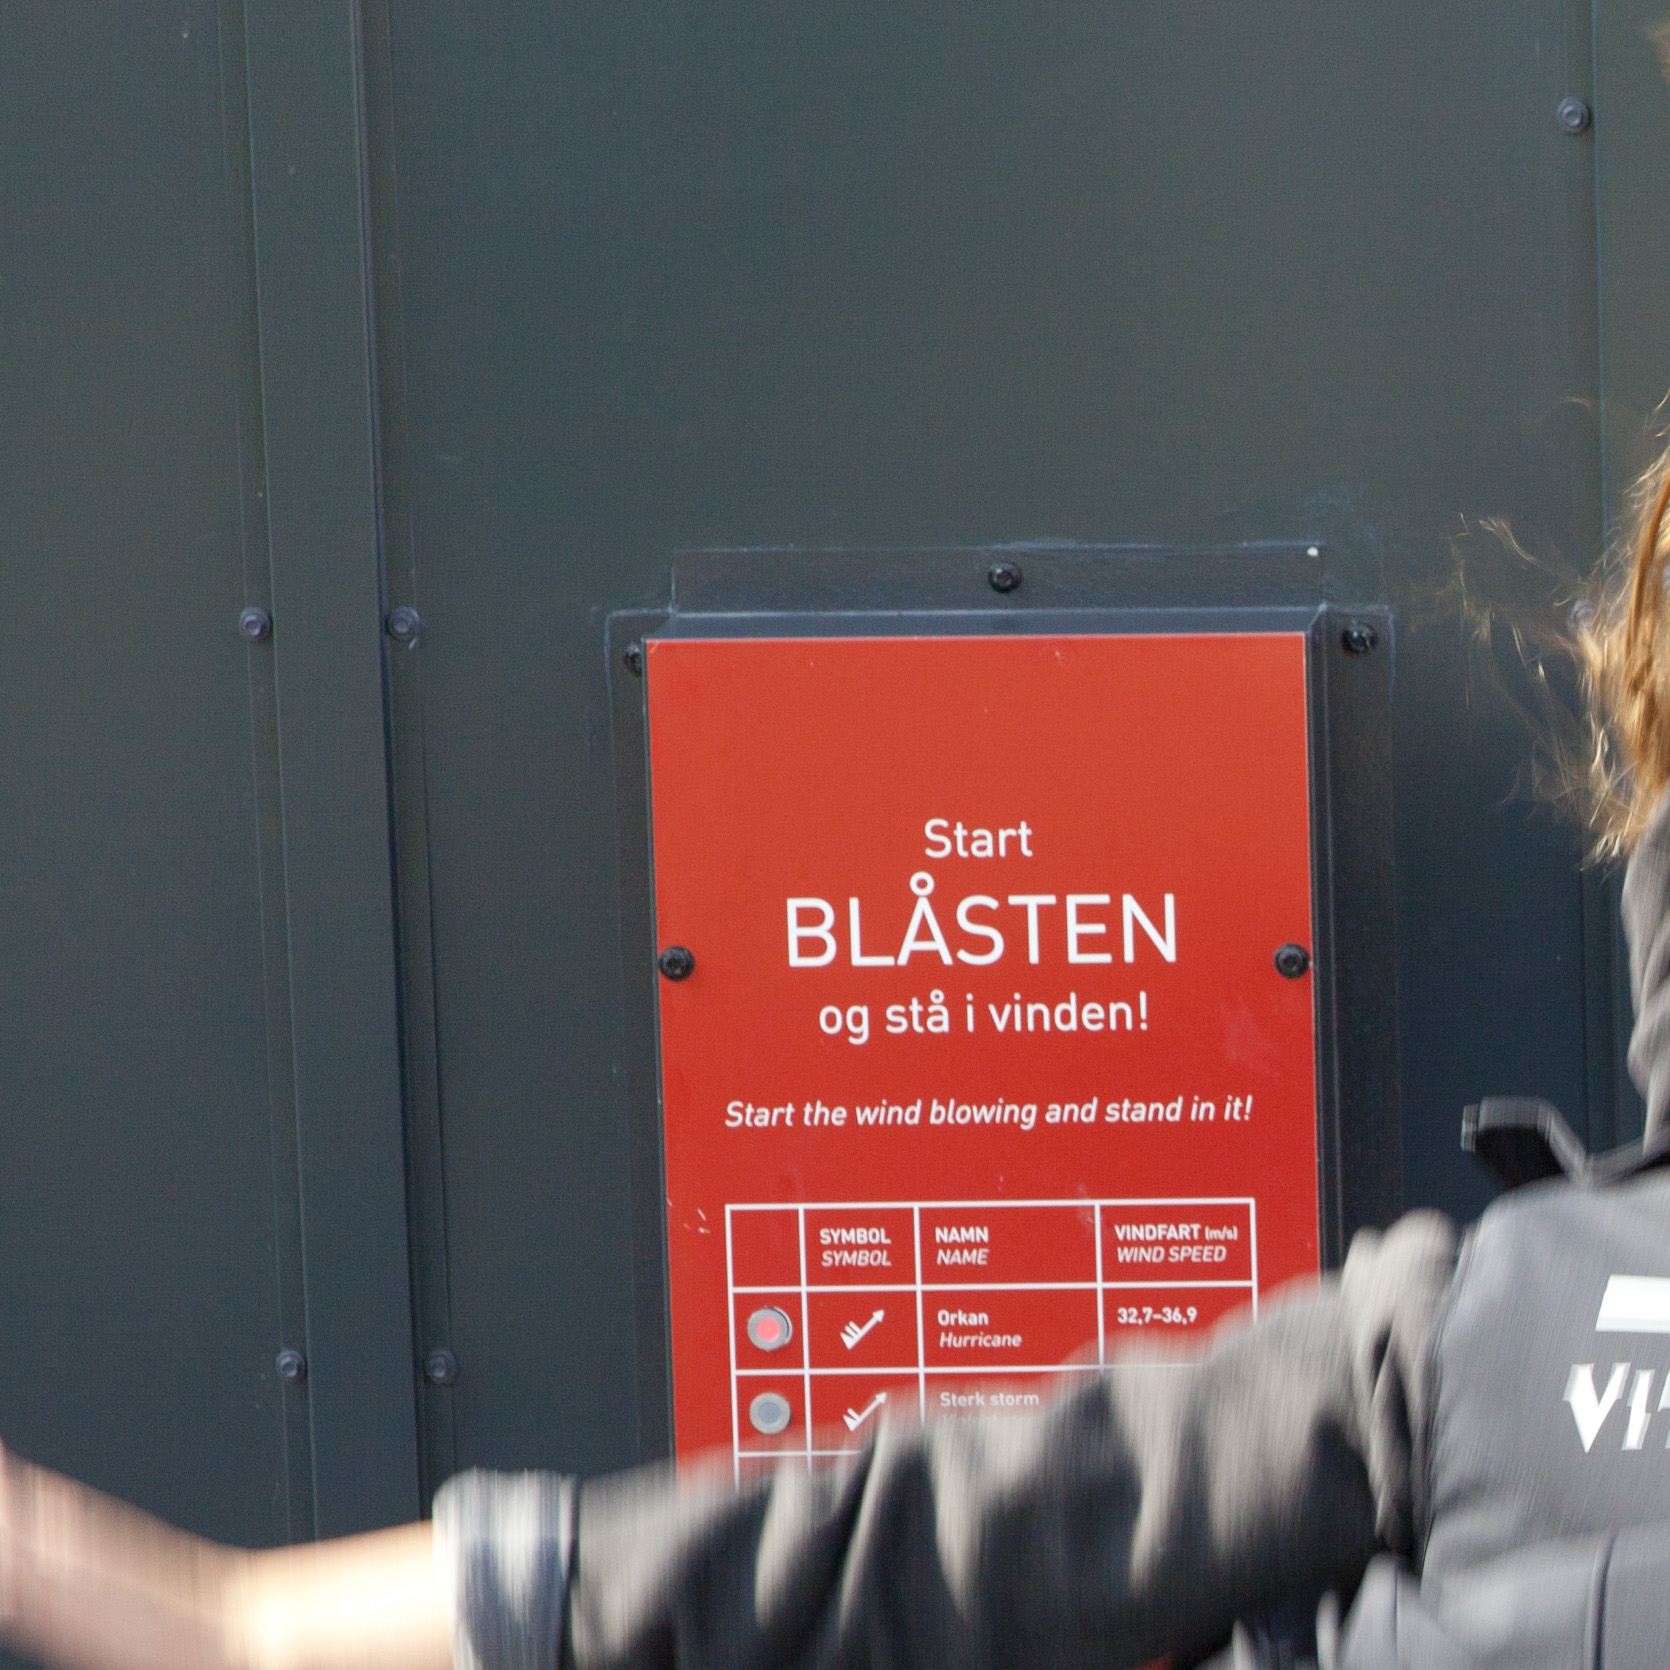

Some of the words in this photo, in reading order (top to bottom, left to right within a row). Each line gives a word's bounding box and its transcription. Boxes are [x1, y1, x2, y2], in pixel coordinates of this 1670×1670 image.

[924, 818, 1033, 859] Start
[786, 871, 1177, 968] BLÅSTEN
[819, 1005, 870, 1045] og
[885, 989, 950, 1034] stå
[966, 993, 974, 1033] i
[988, 991, 1148, 1032] vinden!
[725, 1100, 795, 1128] Start
[803, 1100, 848, 1127] the
[855, 1099, 922, 1126] wind
[929, 1097, 1038, 1131] blowing
[1044, 1096, 1098, 1124] and
[1104, 1095, 1184, 1123] stand
[1190, 1095, 1216, 1121] in
[1224, 1094, 1253, 1121] it!
[819, 1227, 892, 1245] SYMBOL
[935, 1226, 989, 1243] NAMN
[1114, 1223, 1201, 1241] VINDFART
[821, 1249, 892, 1267] SYMBOL
[936, 1248, 989, 1265] NAME
[1117, 1246, 1165, 1263] WIND
[1168, 1245, 1227, 1263] SPEED
[937, 1309, 989, 1327] Orkan
[939, 1331, 1023, 1348] Hurricane
[940, 1392, 985, 1407] Sterk
[990, 1392, 1039, 1407] storm
